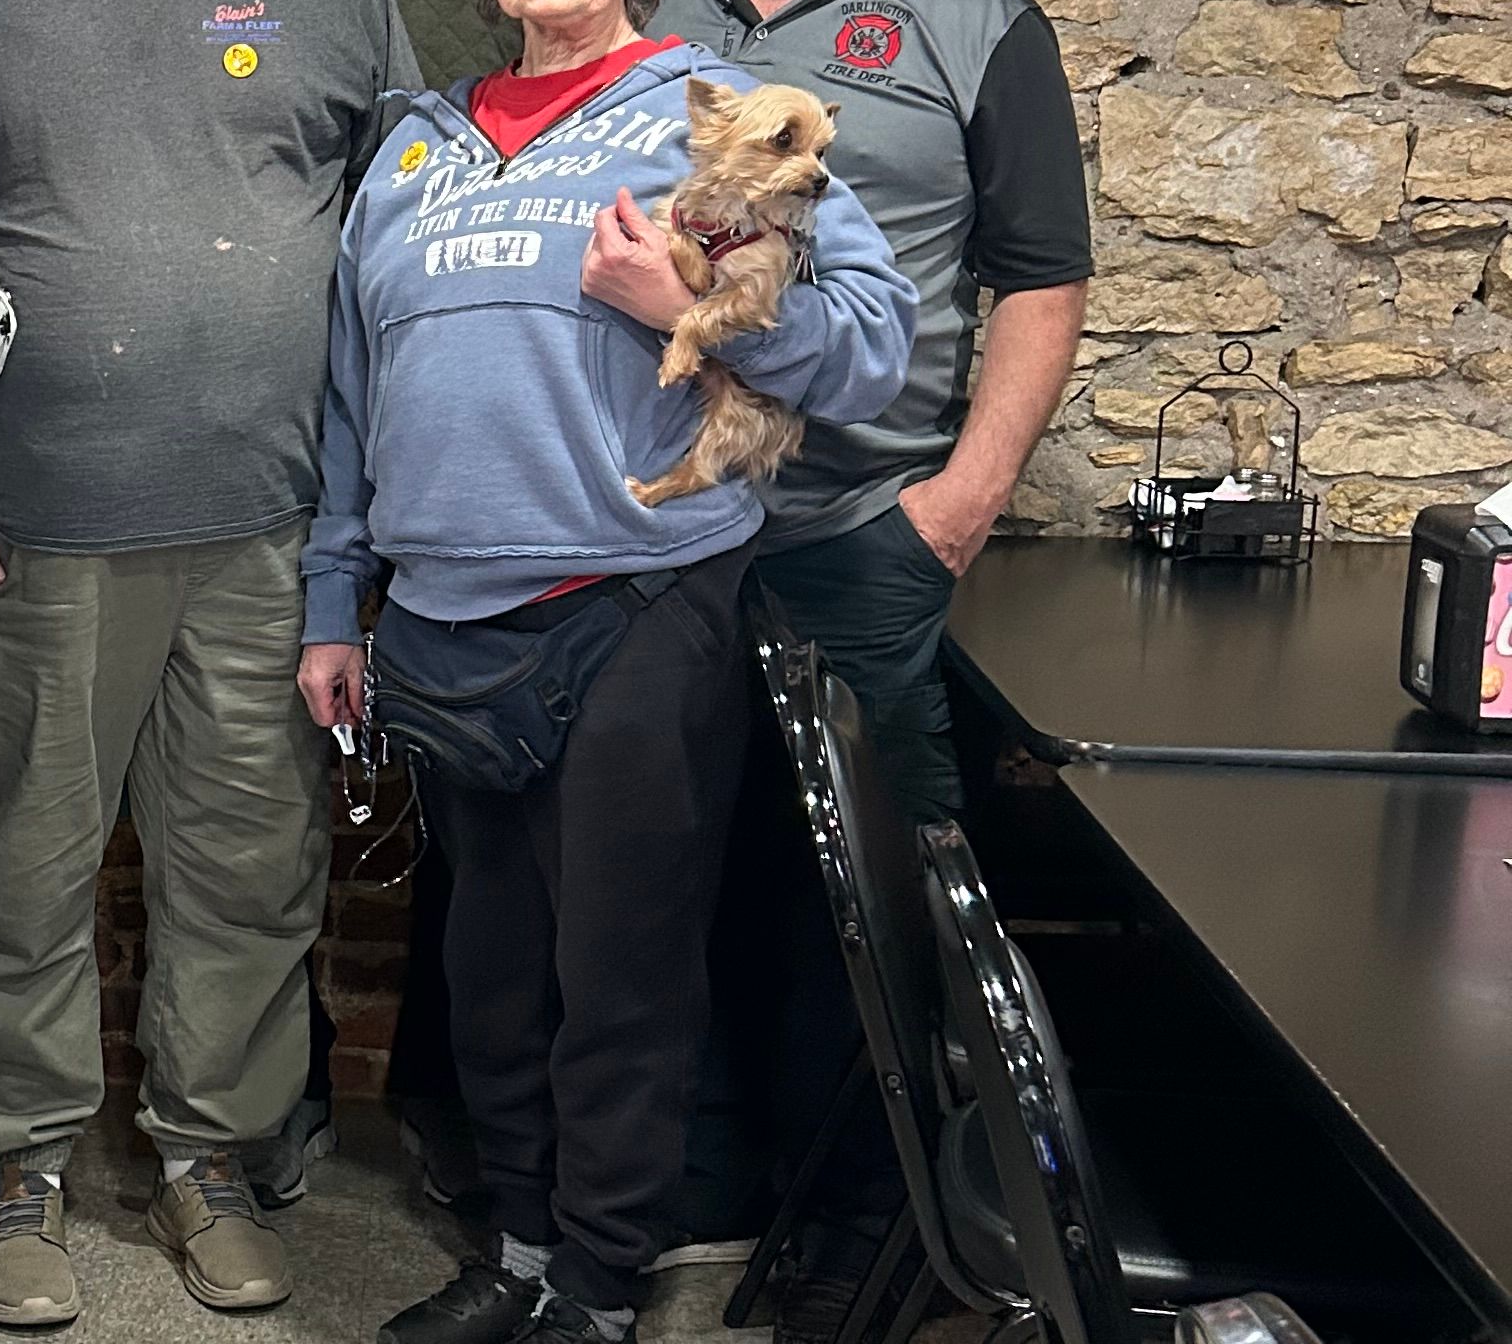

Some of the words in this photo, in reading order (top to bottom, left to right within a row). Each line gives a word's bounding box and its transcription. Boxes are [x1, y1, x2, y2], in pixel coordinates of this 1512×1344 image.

[215, 0, 265, 22] Blain's
[841, 1, 914, 25] DARLINGTON
[245, 20, 281, 31] FLEET
[823, 63, 857, 78] FIRE
[404, 207, 463, 244] LIVIN
[468, 199, 511, 227] THE
[513, 197, 601, 229] DREAM
